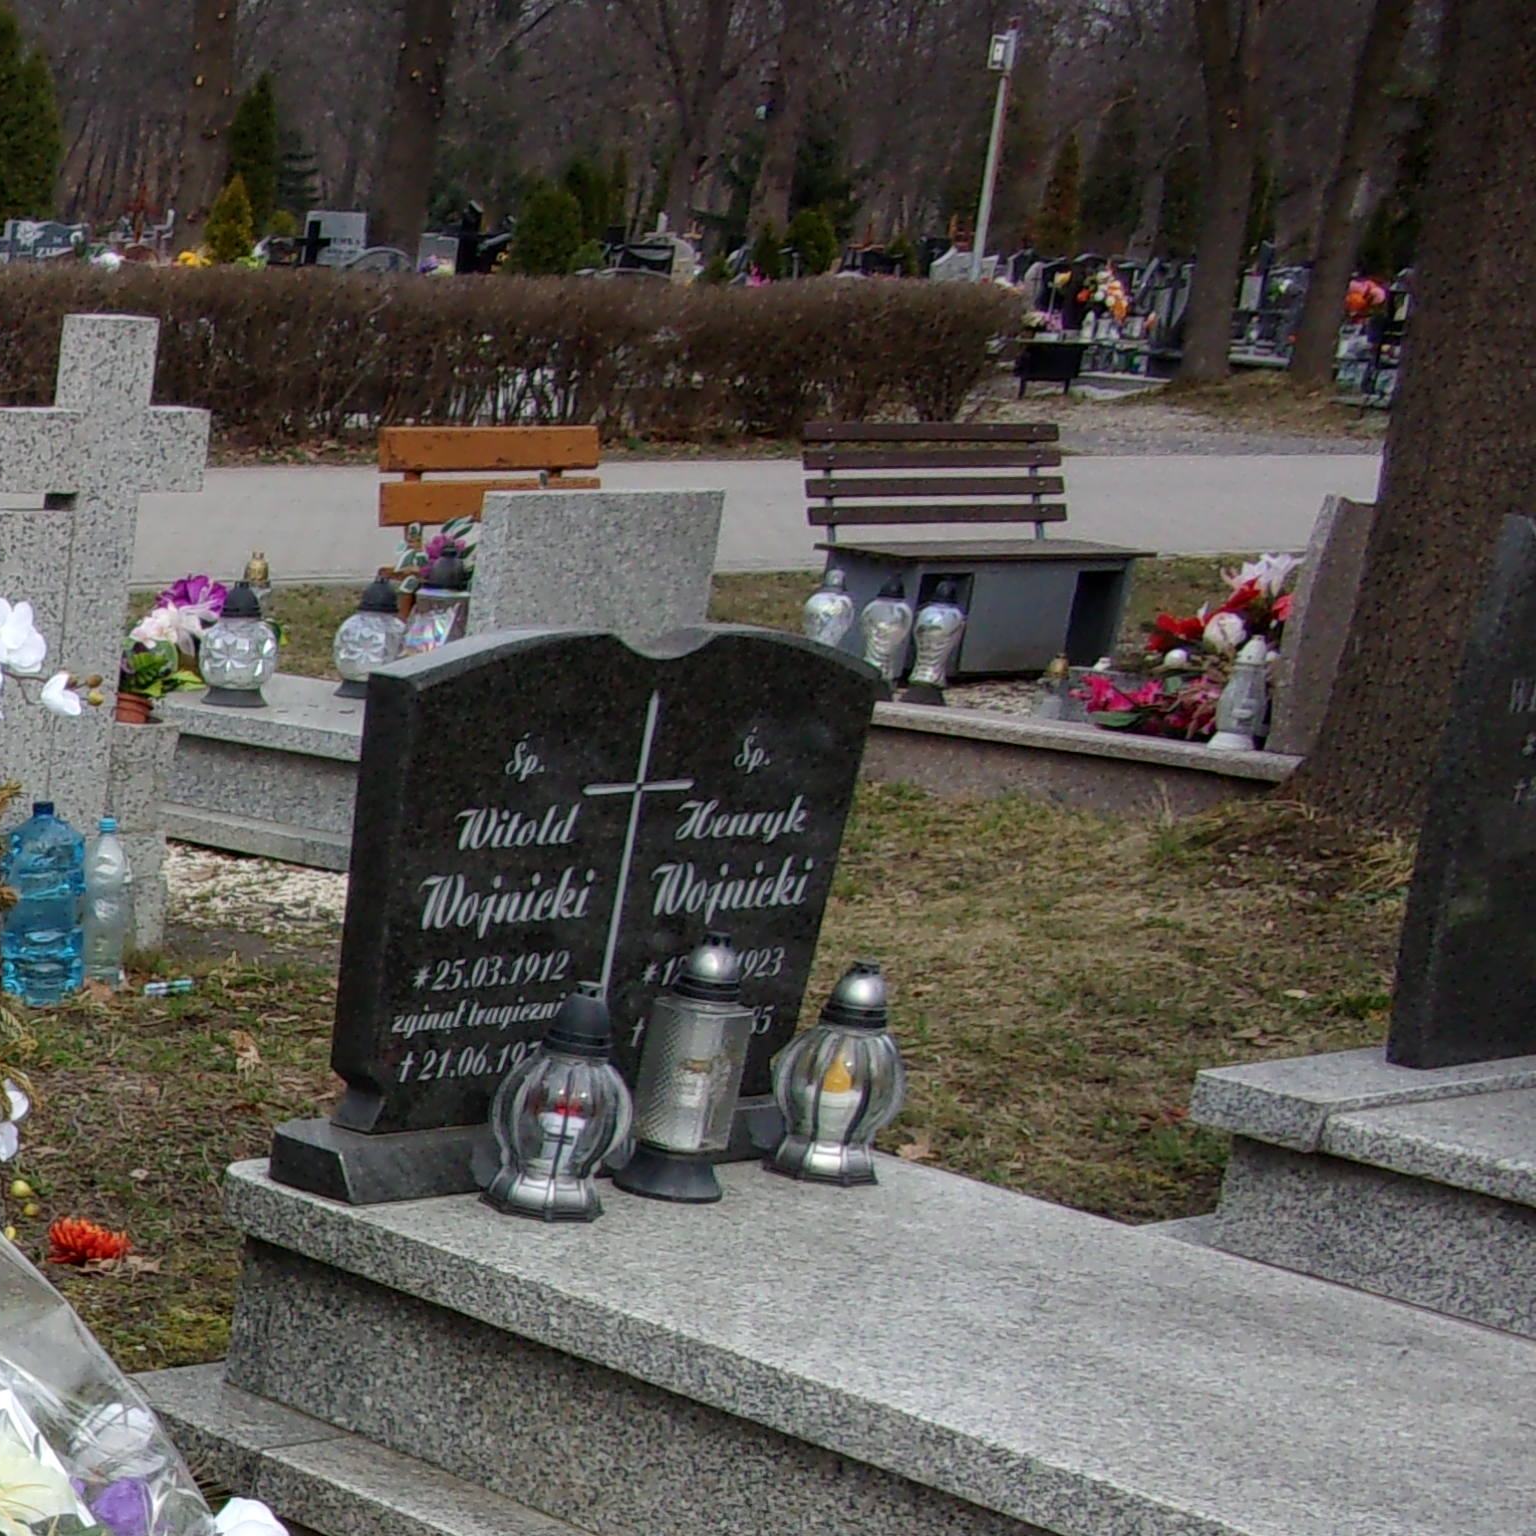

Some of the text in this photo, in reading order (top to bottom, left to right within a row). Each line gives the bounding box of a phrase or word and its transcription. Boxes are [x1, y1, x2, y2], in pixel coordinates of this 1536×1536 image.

[504, 730, 546, 782] Śp.
[732, 726, 773, 772] Śp.
[454, 801, 583, 853] Witold
[673, 793, 809, 846] Henryk
[417, 866, 596, 939] Wojnicki
[649, 855, 815, 928] Wojnicki
